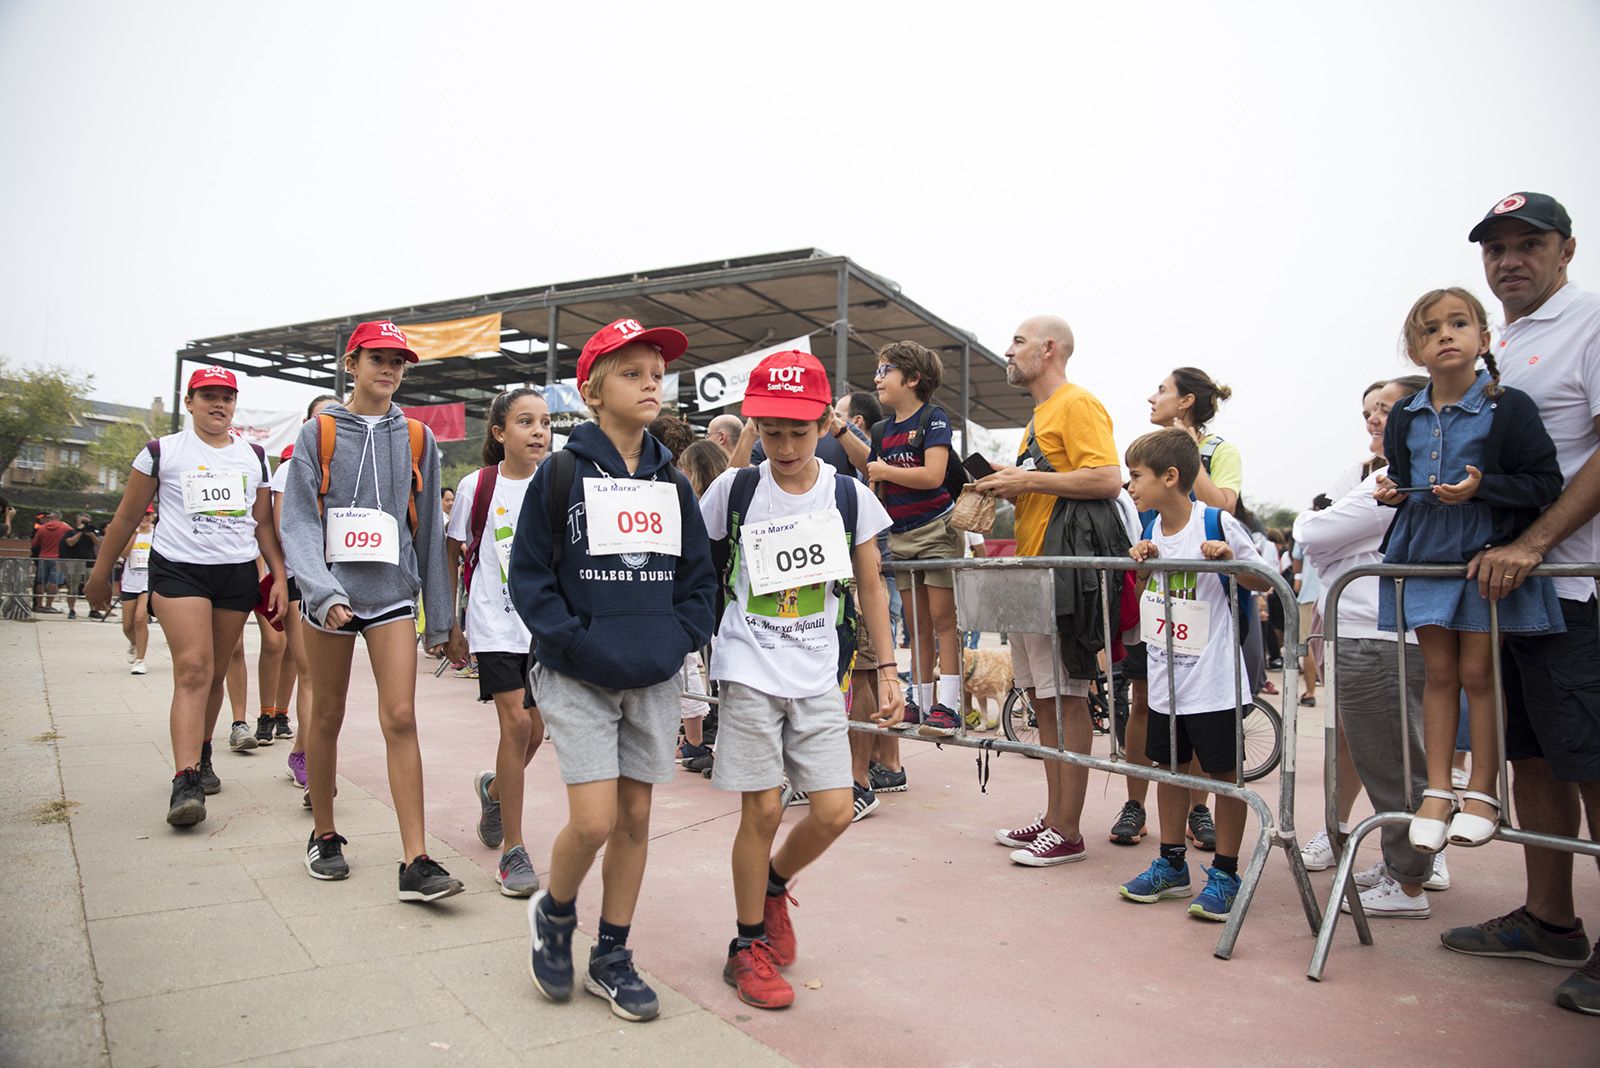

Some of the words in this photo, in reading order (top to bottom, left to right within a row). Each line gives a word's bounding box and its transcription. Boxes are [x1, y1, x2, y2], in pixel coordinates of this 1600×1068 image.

[769, 366, 806, 383] TOT
[767, 383, 782, 391] Sant
[784, 384, 804, 393] Cugat
[201, 488, 231, 501] 100
[594, 484, 608, 492] "La
[611, 483, 641, 492] Marxa"
[617, 511, 663, 534] 098
[768, 521, 798, 534] Marxa"
[344, 531, 382, 548] 099
[776, 543, 825, 573] 098
[580, 569, 633, 581] COLLEGE
[640, 570, 675, 581] DUBLI
[761, 620, 793, 633] Marxa
[794, 617, 825, 633] Infantil
